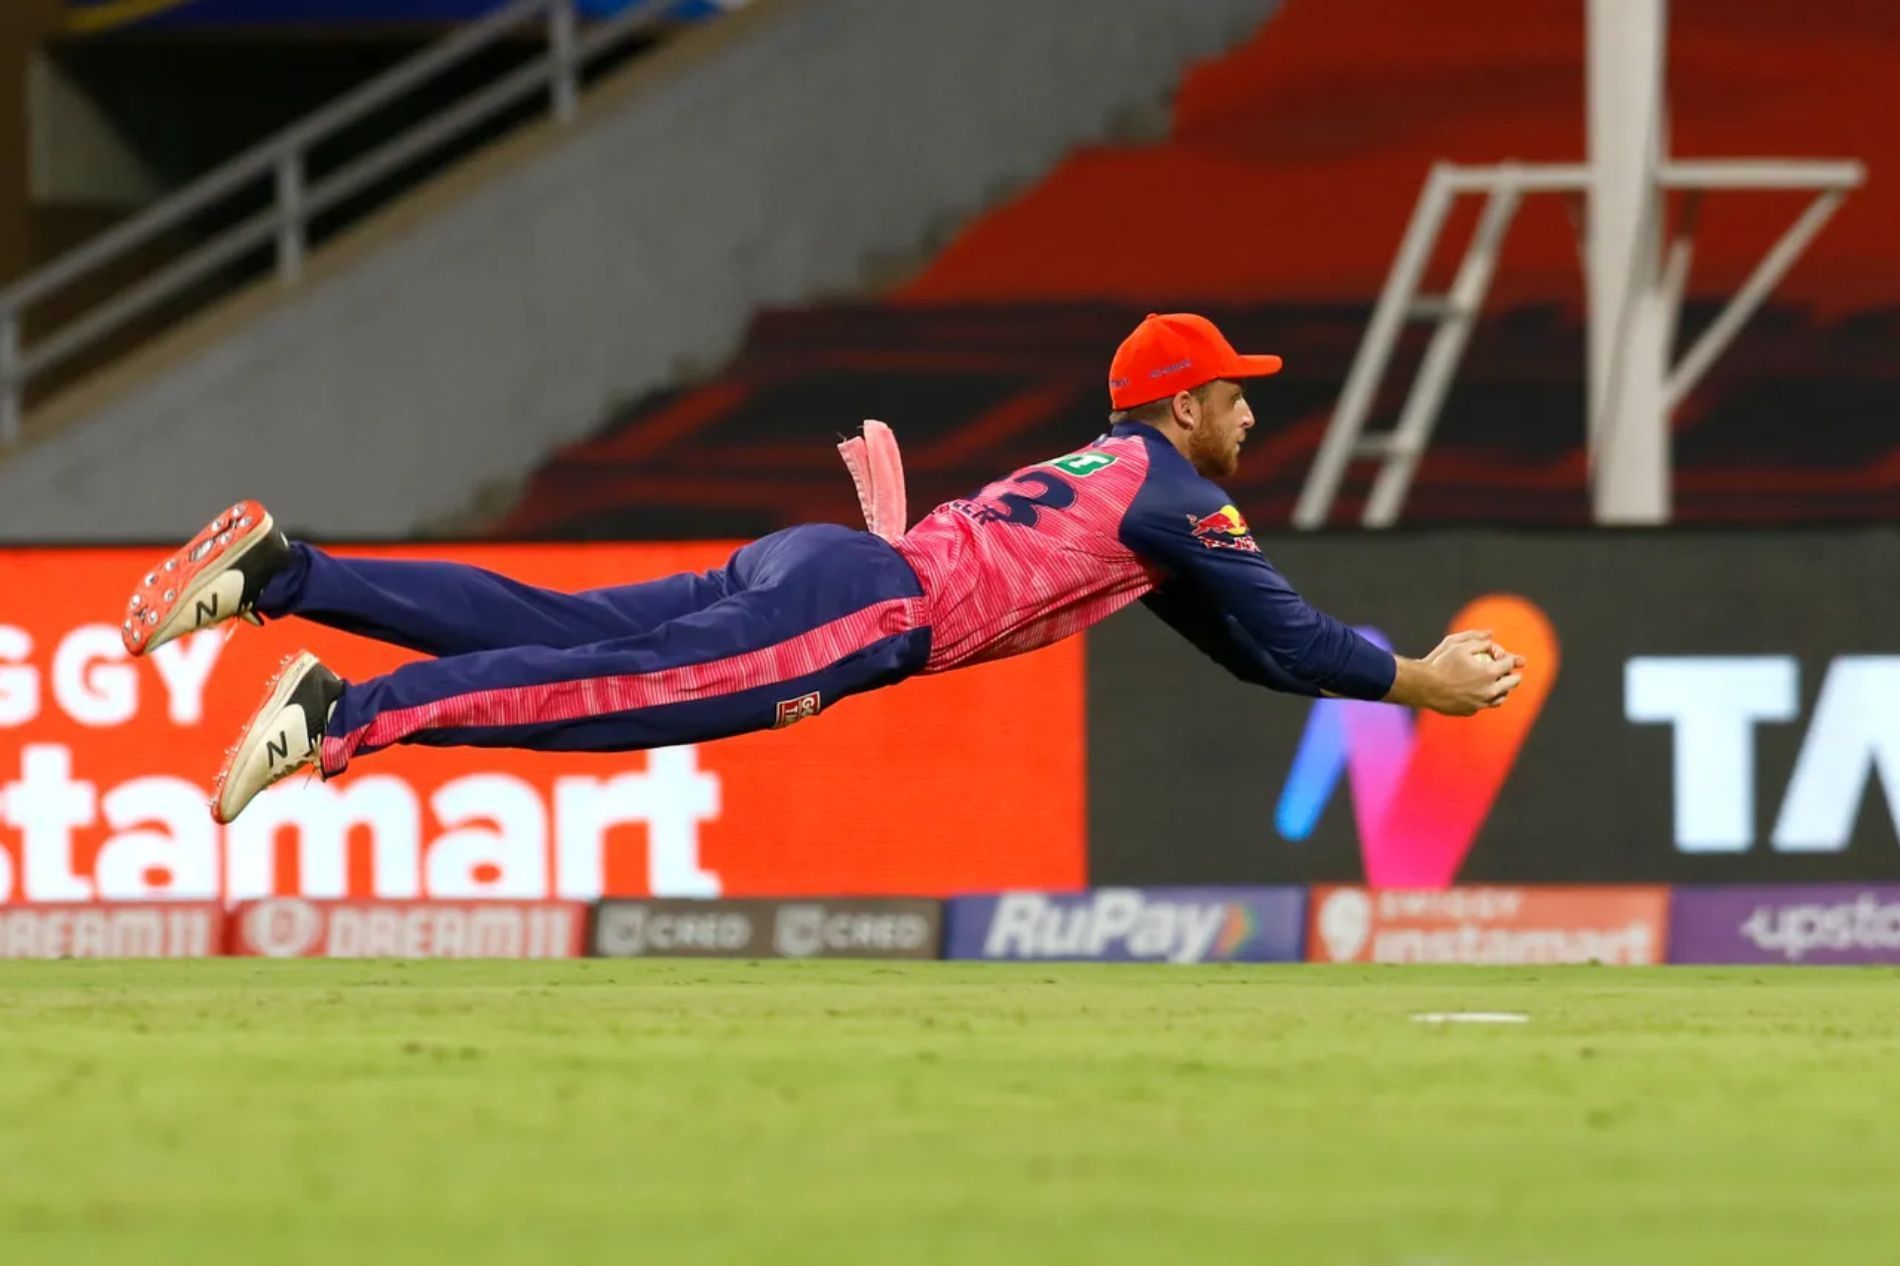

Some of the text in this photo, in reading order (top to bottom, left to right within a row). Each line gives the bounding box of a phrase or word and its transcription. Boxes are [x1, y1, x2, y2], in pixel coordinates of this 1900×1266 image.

[196, 592, 218, 627] N
[266, 730, 288, 768] N
[1623, 654, 1900, 853] TA
[0, 743, 723, 900] tamart
[327, 905, 575, 957] DREAM11
[651, 914, 749, 949] CRED
[825, 914, 929, 949] CRED
[985, 888, 1223, 963] RuPay
